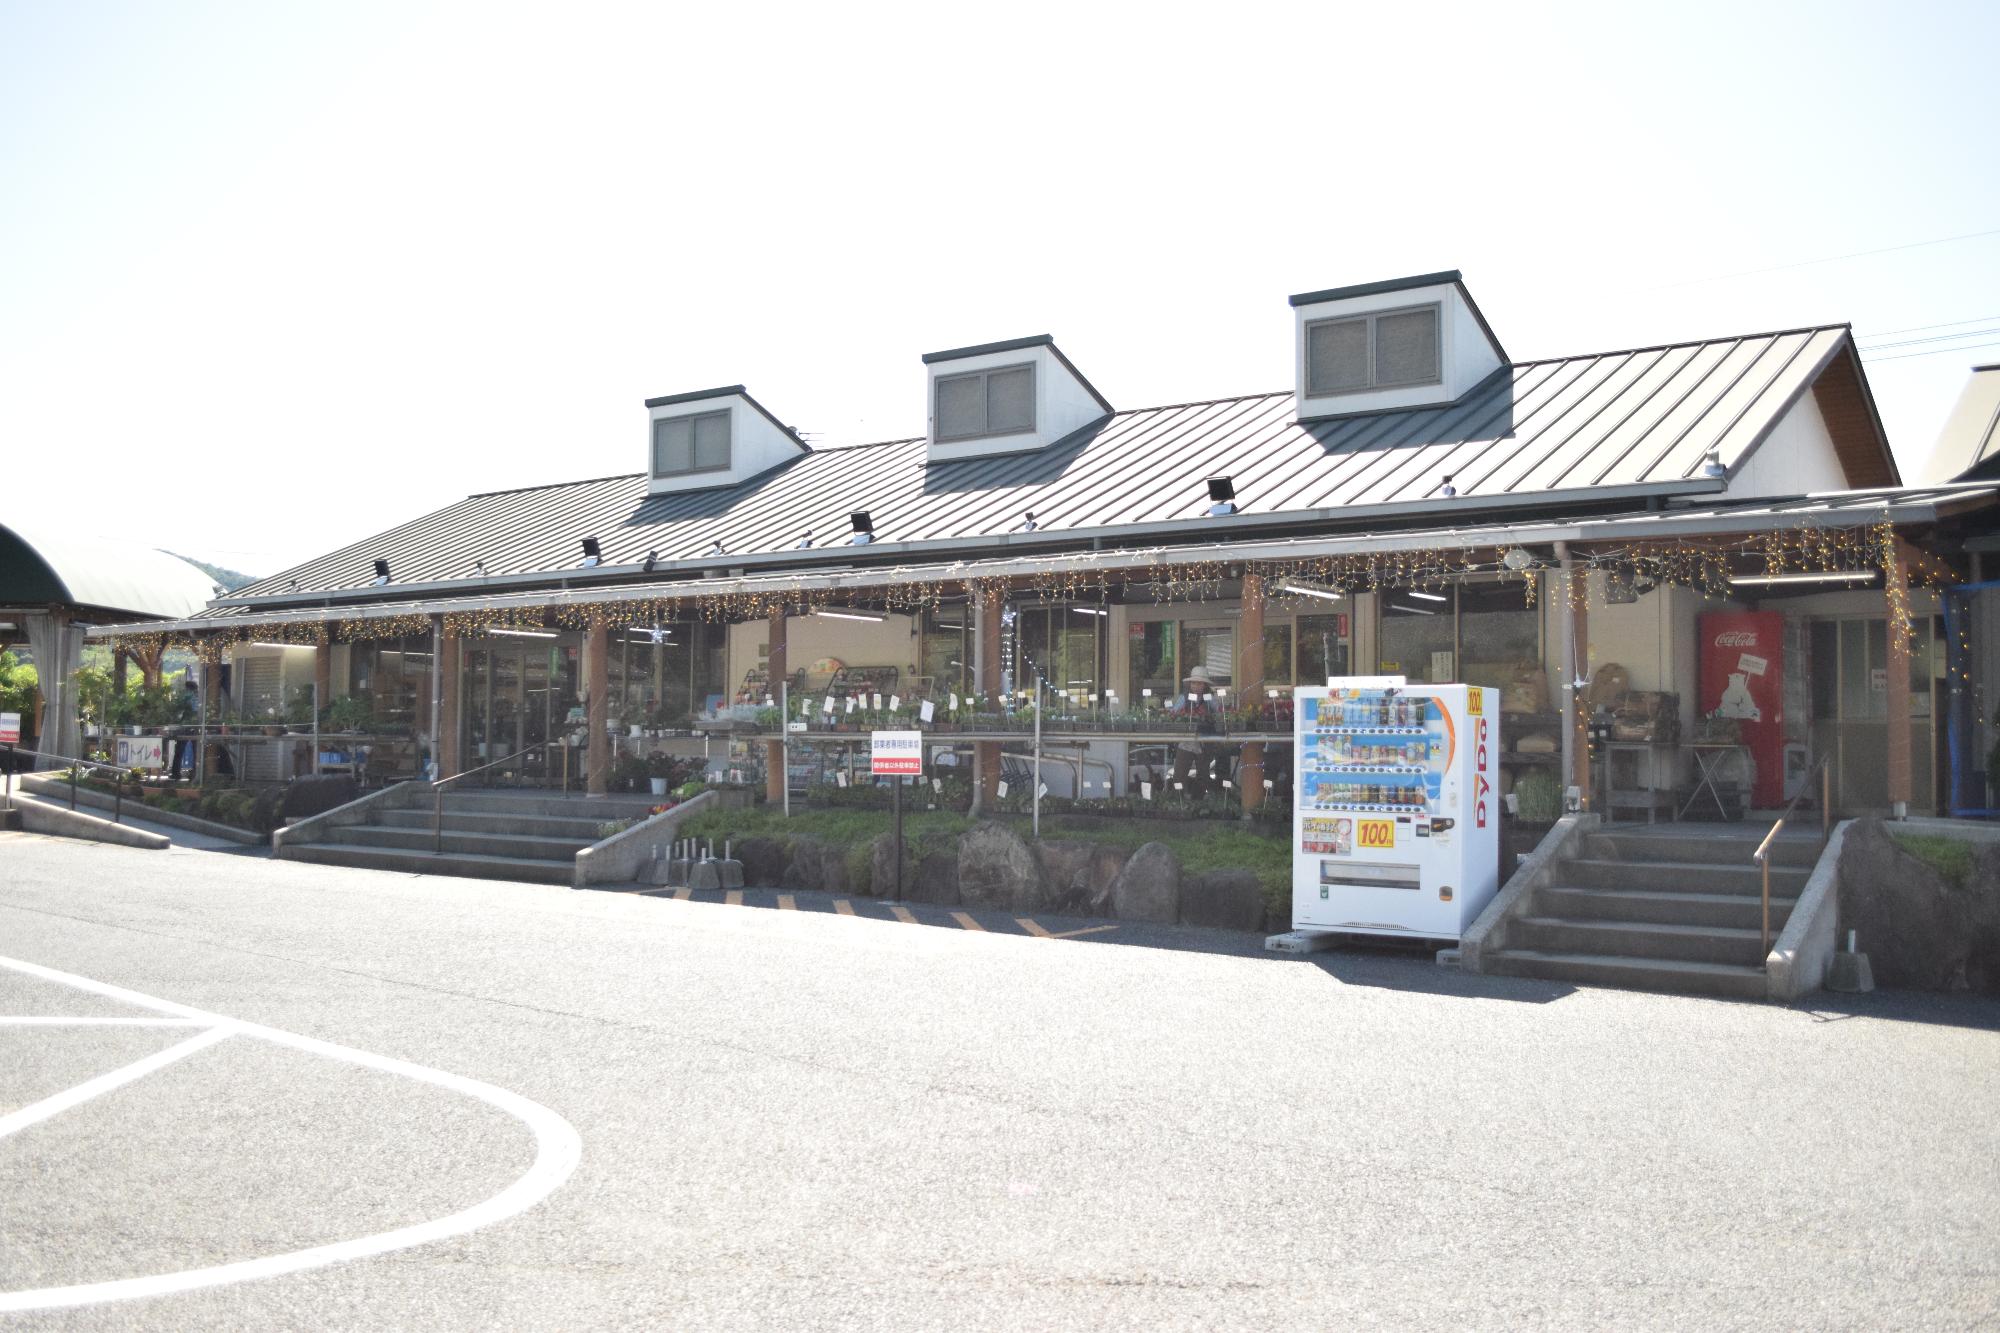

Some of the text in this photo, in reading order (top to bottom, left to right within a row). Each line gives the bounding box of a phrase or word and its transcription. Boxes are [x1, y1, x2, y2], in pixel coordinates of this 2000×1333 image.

[1714, 631, 1758, 647] Coca-Cola
[130, 743, 152, 761] トイレ
